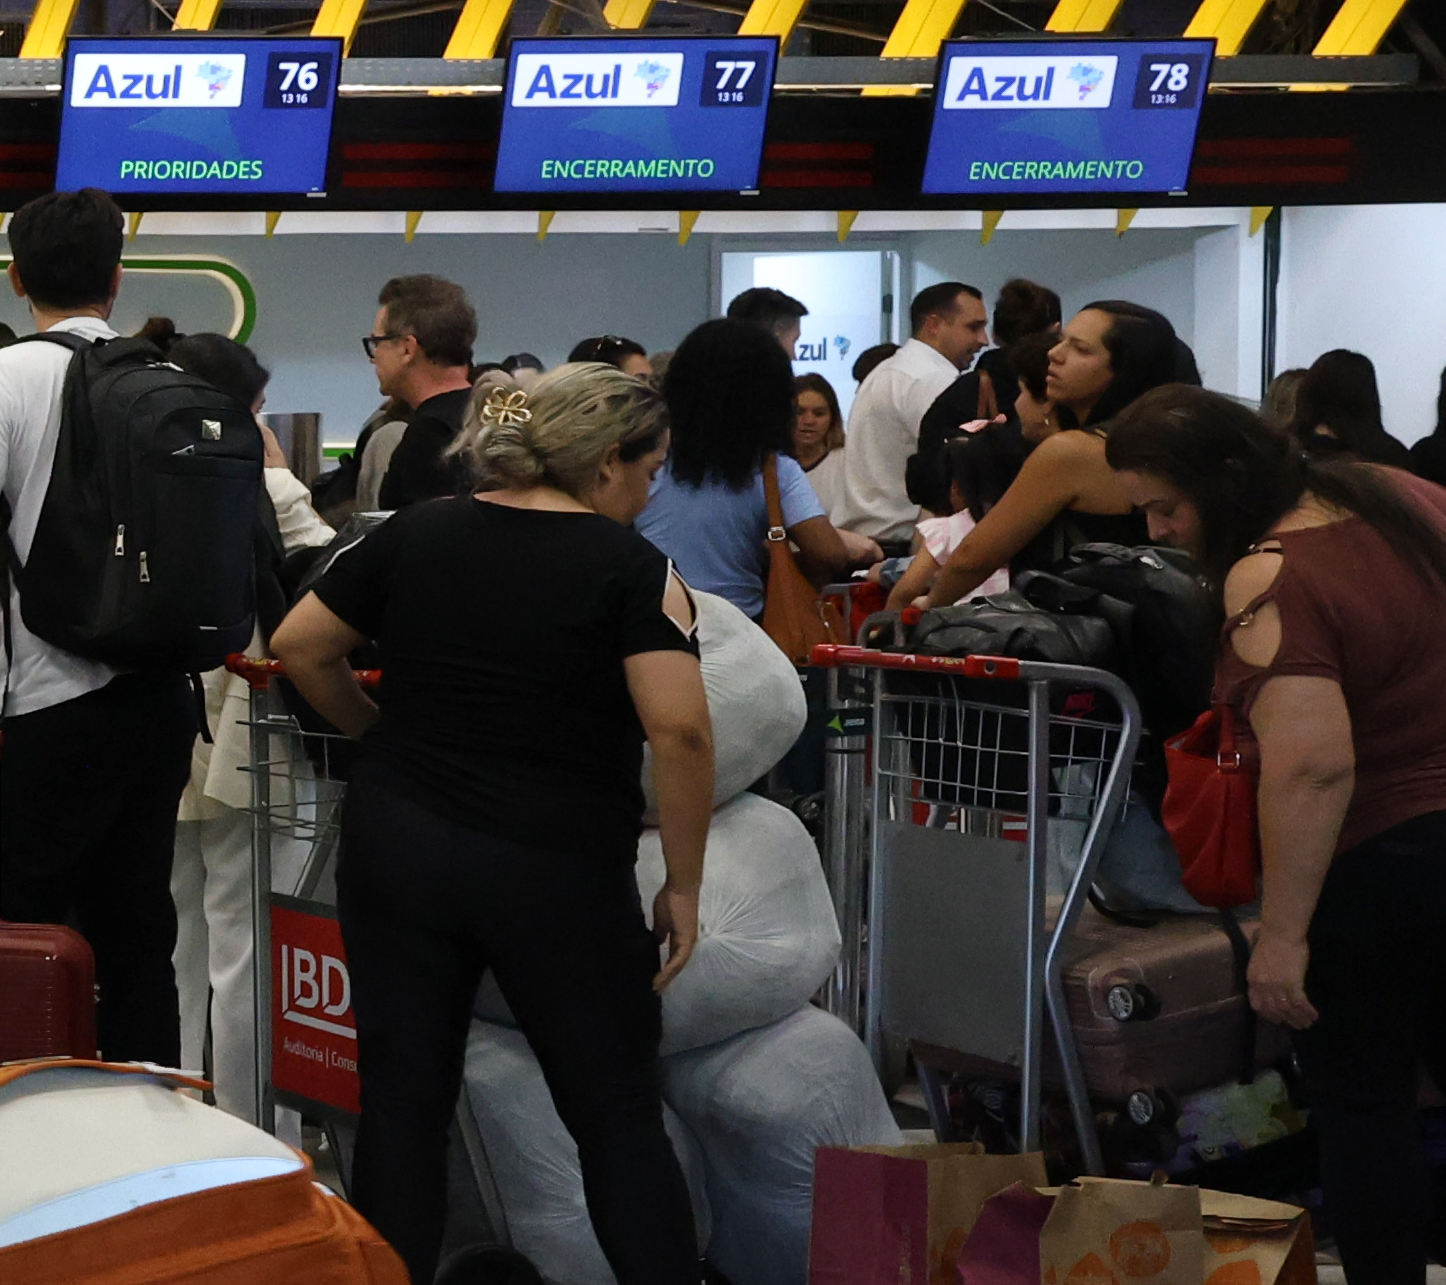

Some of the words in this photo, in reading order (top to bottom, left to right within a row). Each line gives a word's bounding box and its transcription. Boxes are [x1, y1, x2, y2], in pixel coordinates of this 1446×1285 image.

[84, 64, 183, 99] Azul
[279, 62, 319, 91] 76
[525, 64, 622, 99] Azul
[715, 61, 756, 89] 77
[955, 66, 1055, 101] Azul
[1149, 63, 1189, 91] 78
[121, 160, 263, 180] PRIORIDADES
[541, 160, 715, 179] ENCERRAMENTO
[970, 161, 1143, 180] ENCERRAMENTO
[793, 337, 827, 361] zul
[283, 1036, 324, 1063] Auditoria
